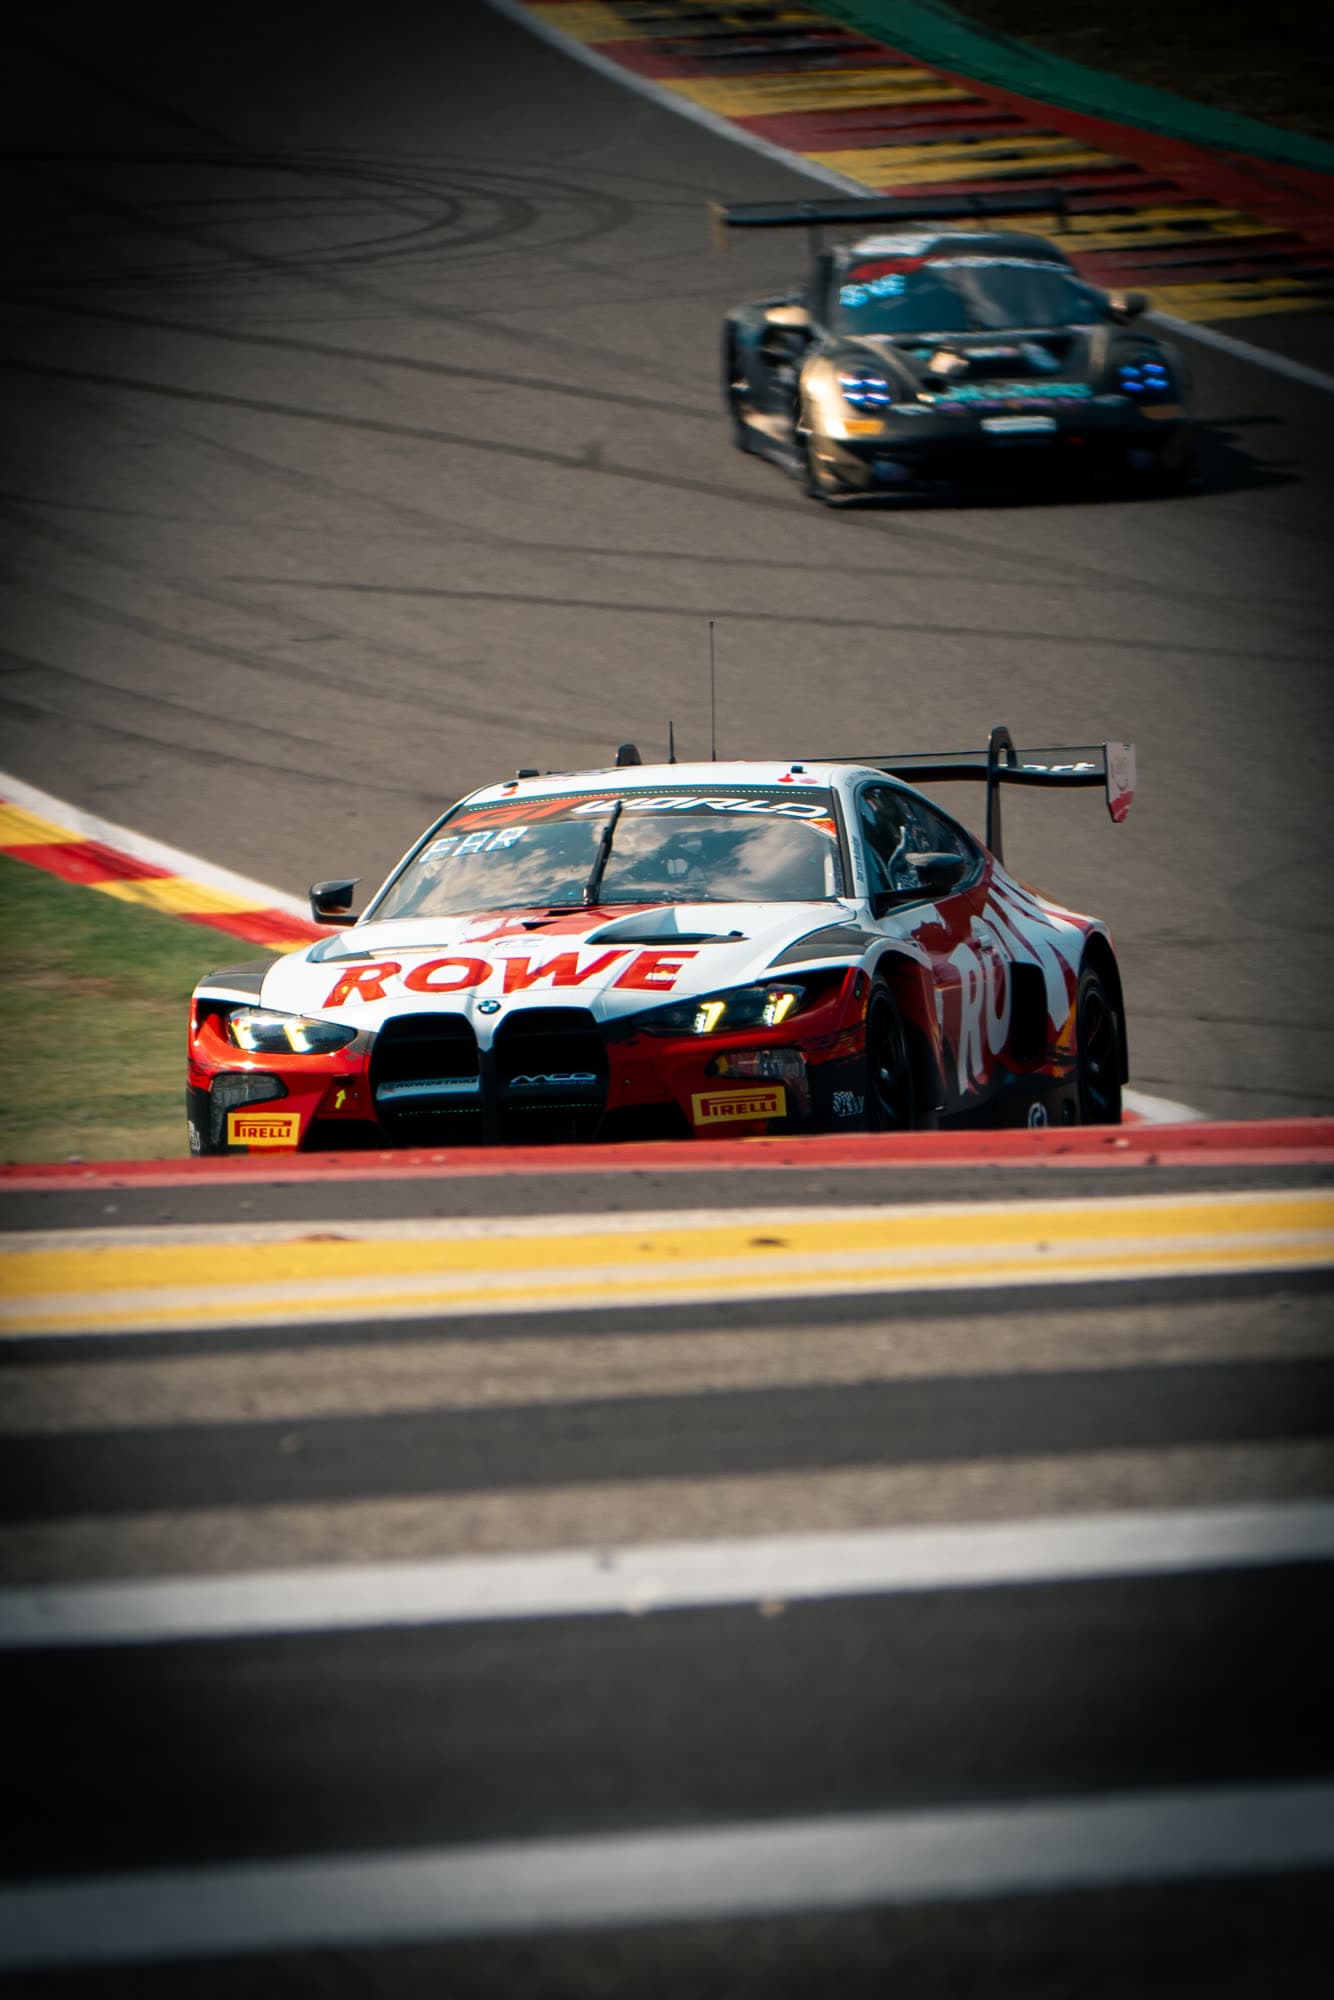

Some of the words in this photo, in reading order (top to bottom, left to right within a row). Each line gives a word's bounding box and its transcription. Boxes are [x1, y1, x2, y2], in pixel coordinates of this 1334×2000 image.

[570, 796, 828, 819] WORLD
[321, 949, 702, 1009] ROWE
[699, 1093, 778, 1117] PIRELLI
[233, 1119, 293, 1138] PIRELLI
